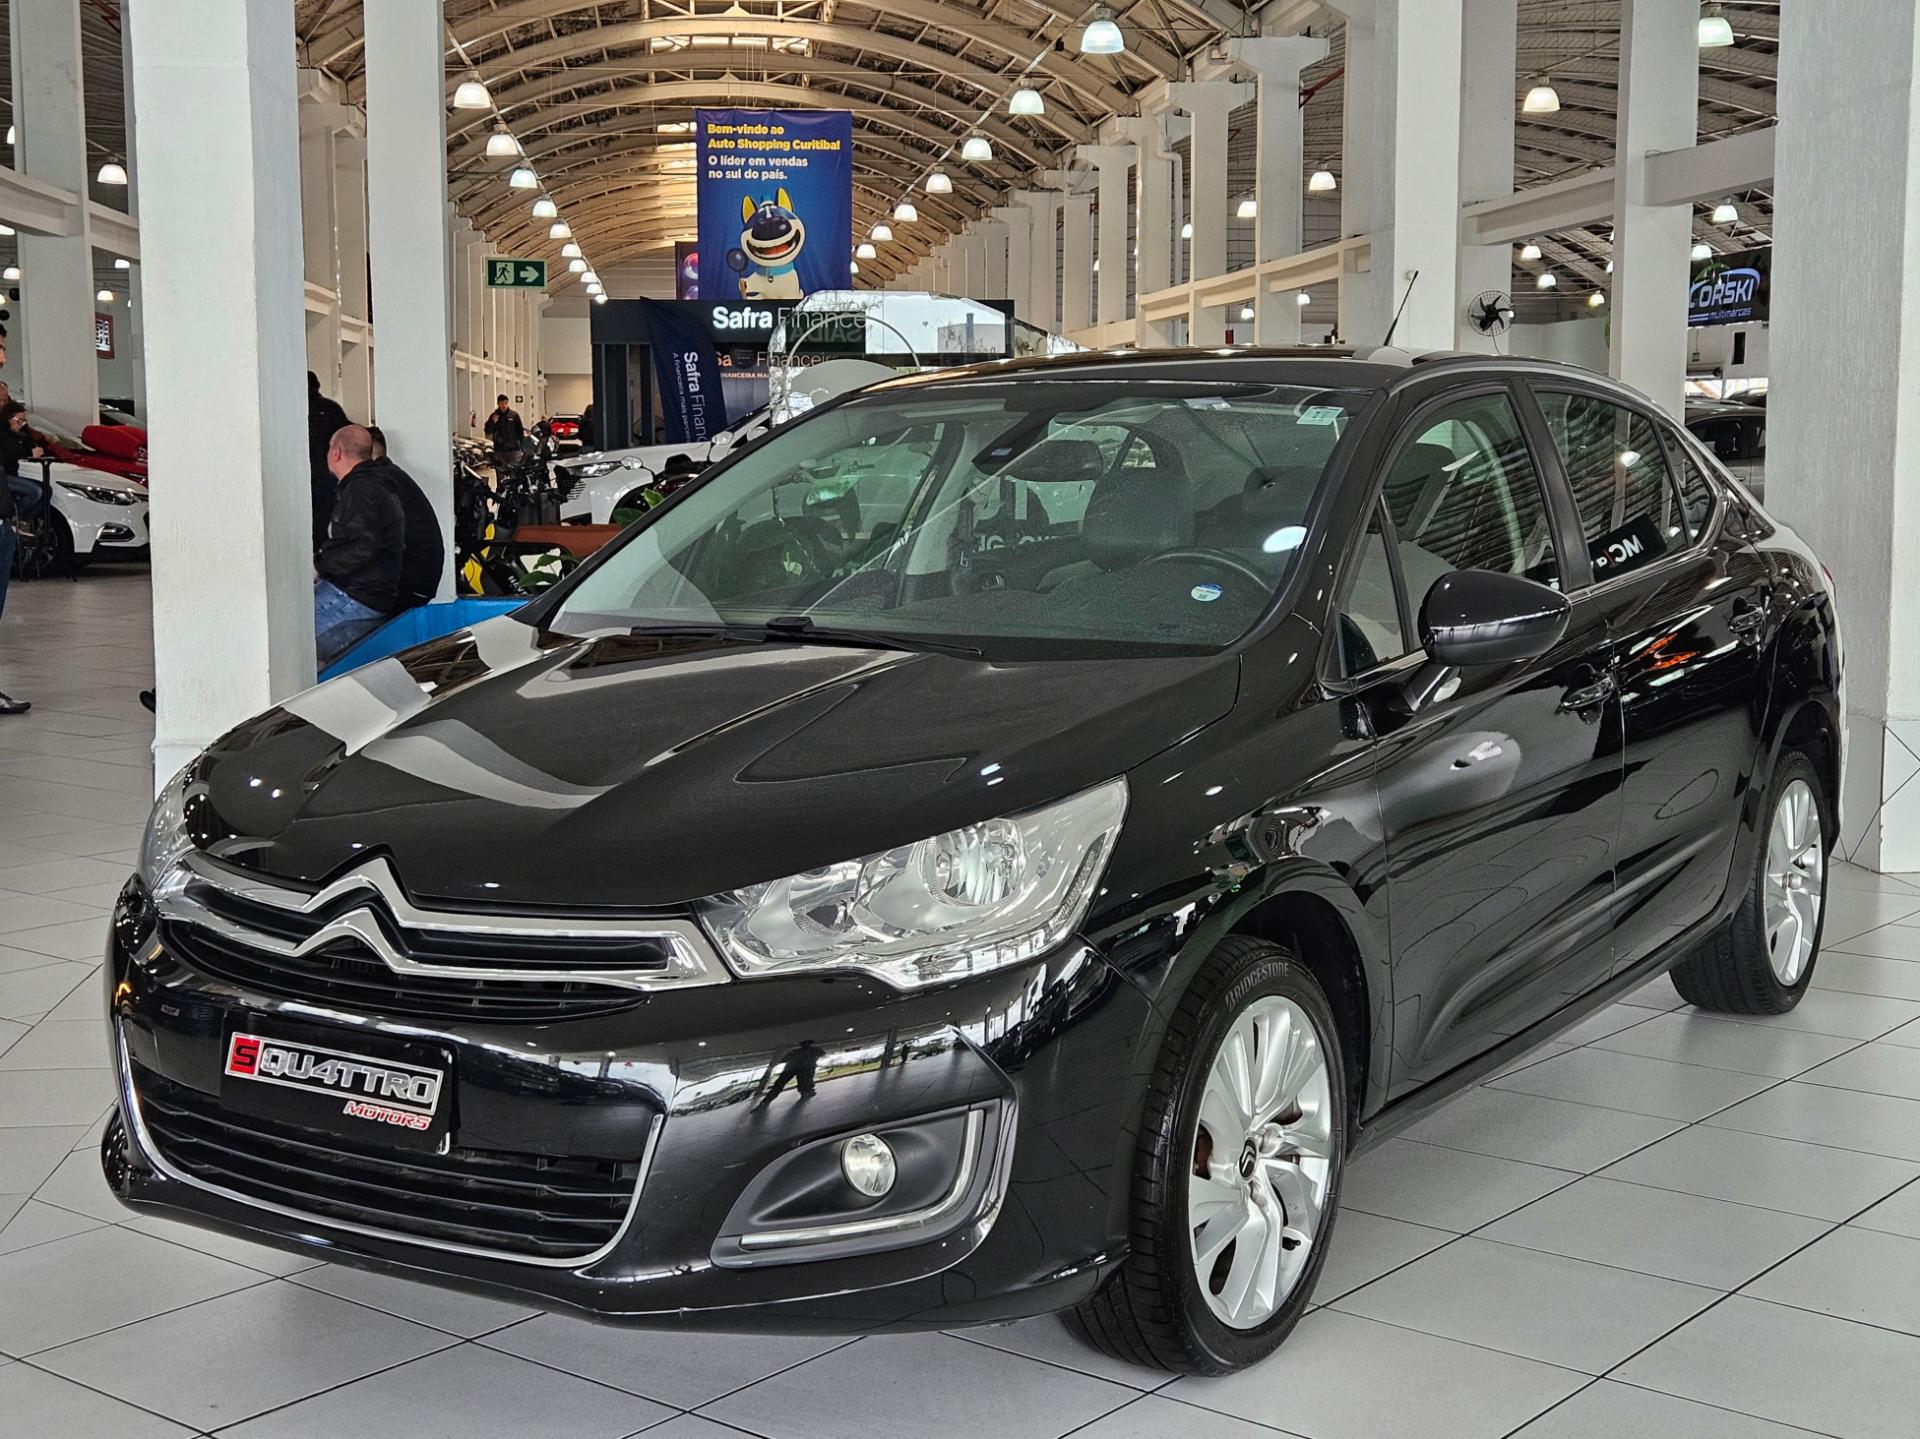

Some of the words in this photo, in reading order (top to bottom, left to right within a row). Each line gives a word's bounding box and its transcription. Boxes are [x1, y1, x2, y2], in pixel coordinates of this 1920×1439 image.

[707, 124, 768, 134] Bem-vindo
[770, 126, 784, 134] ao
[708, 139, 735, 149] Auto
[737, 139, 790, 151] Shopping
[792, 140, 840, 150] Curitiba!
[708, 156, 718, 165] O
[720, 155, 746, 165] líder
[748, 158, 766, 166] em
[768, 157, 808, 167] vendas
[708, 170, 723, 179] no
[725, 169, 741, 179] sul
[744, 169, 759, 179] do
[761, 169, 788, 181] país.
[712, 306, 773, 329] Safra
[683, 352, 702, 393] Safra
[1225, 962, 1289, 1012] BRIDGESTONE
[343, 1100, 433, 1131] MOTORS
